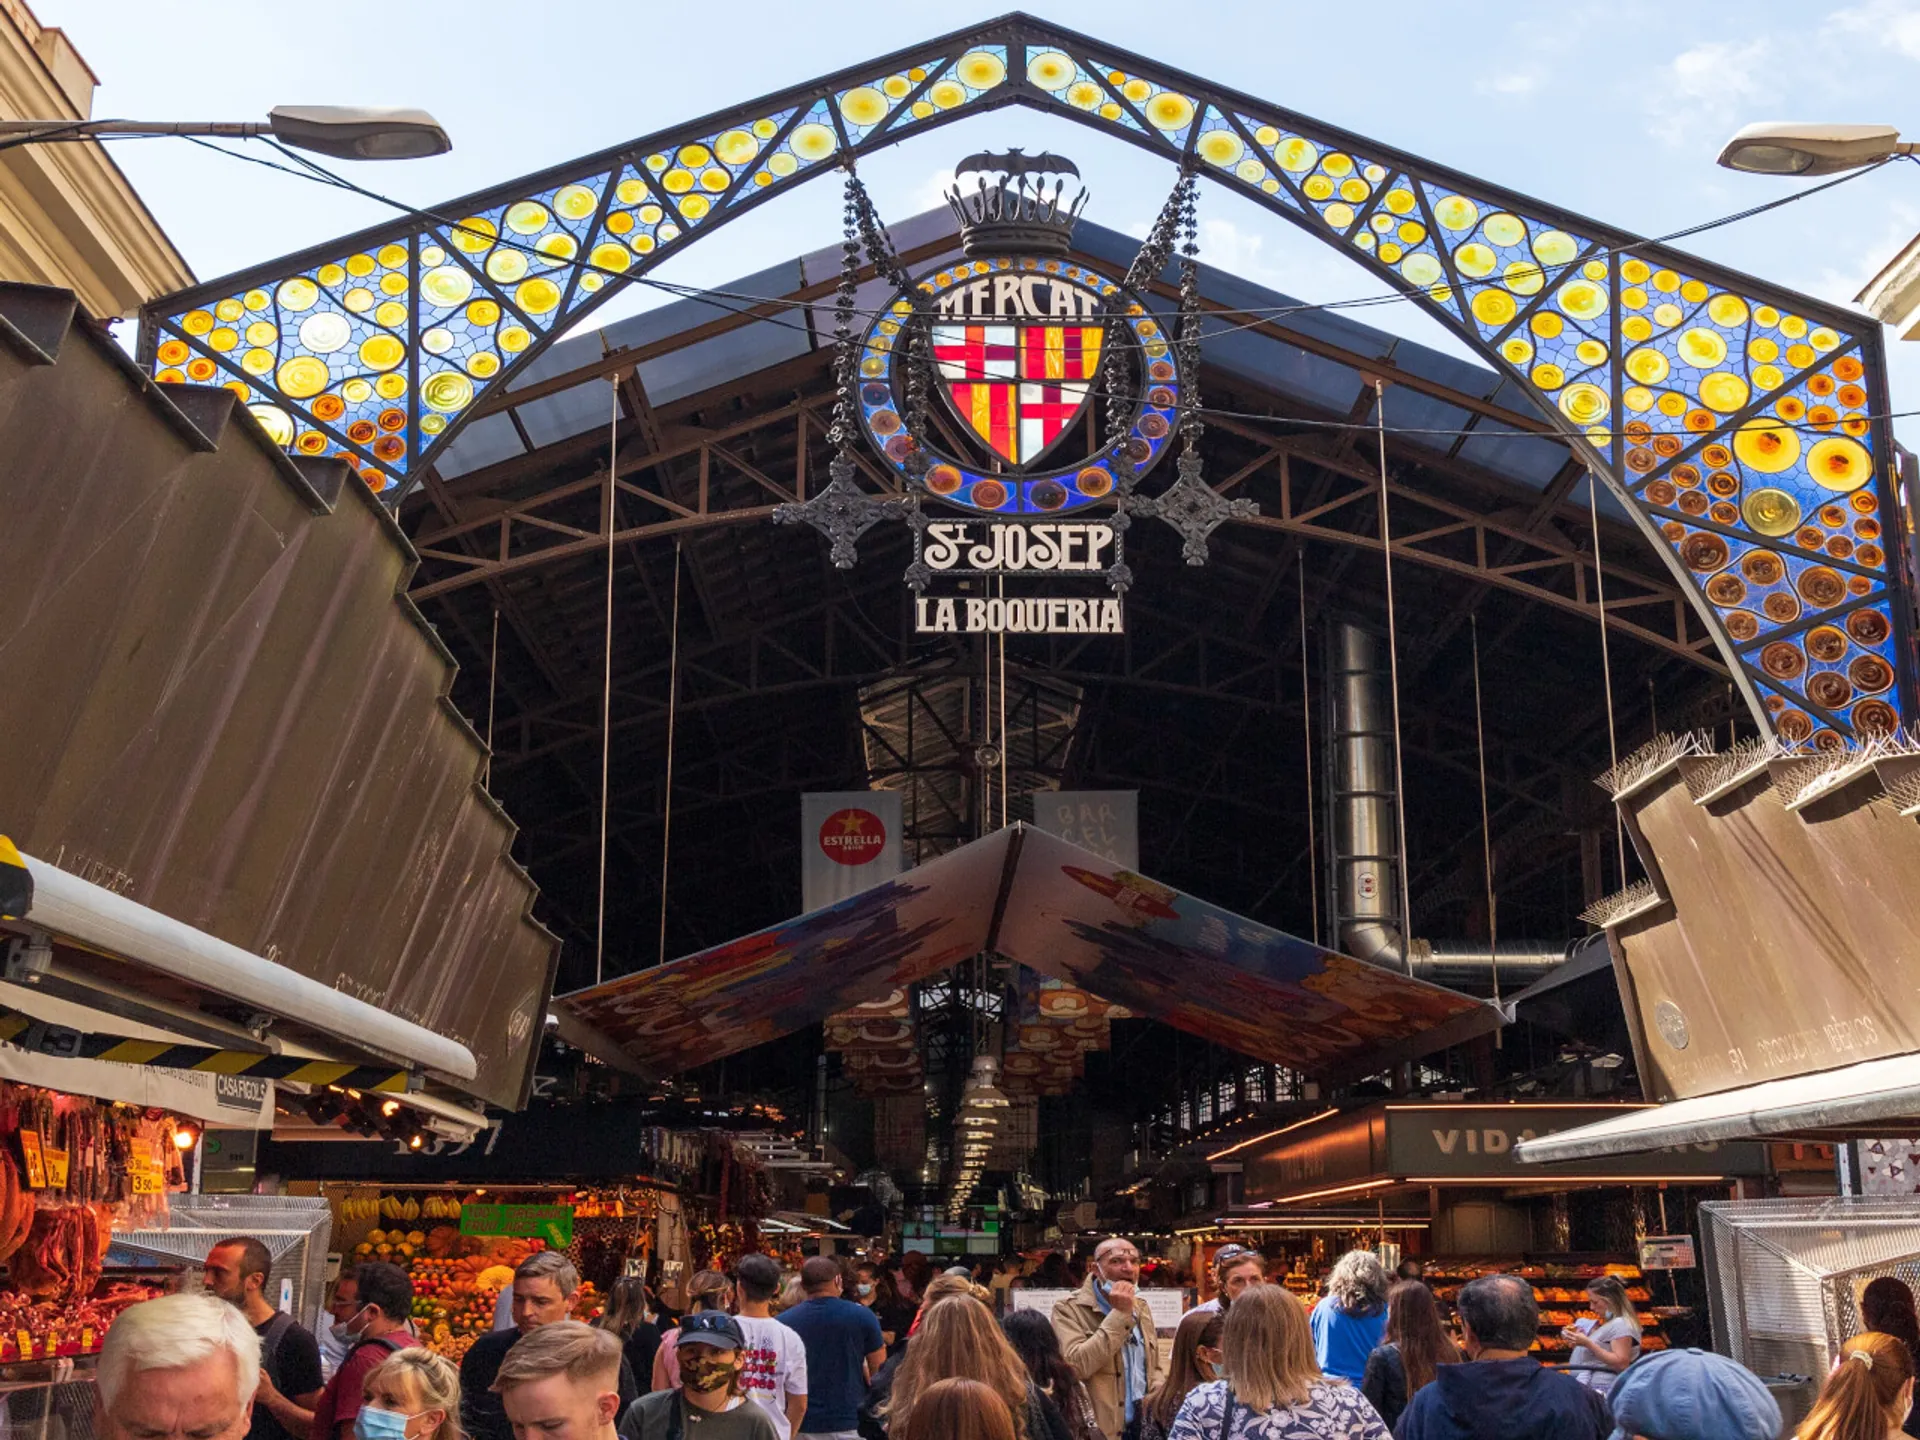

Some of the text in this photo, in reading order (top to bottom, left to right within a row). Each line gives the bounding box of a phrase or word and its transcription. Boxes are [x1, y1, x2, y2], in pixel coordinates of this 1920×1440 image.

[939, 275, 1098, 321] MERCAT
[968, 524, 1113, 570] JOSEP
[917, 598, 1123, 633] LA BOQUERIA
[1057, 803, 1117, 825] BAR
[824, 834, 881, 846] ESTRELLA
[504, 1207, 568, 1219] ORGANIC
[464, 1220, 539, 1233] FRUIT JUICE
